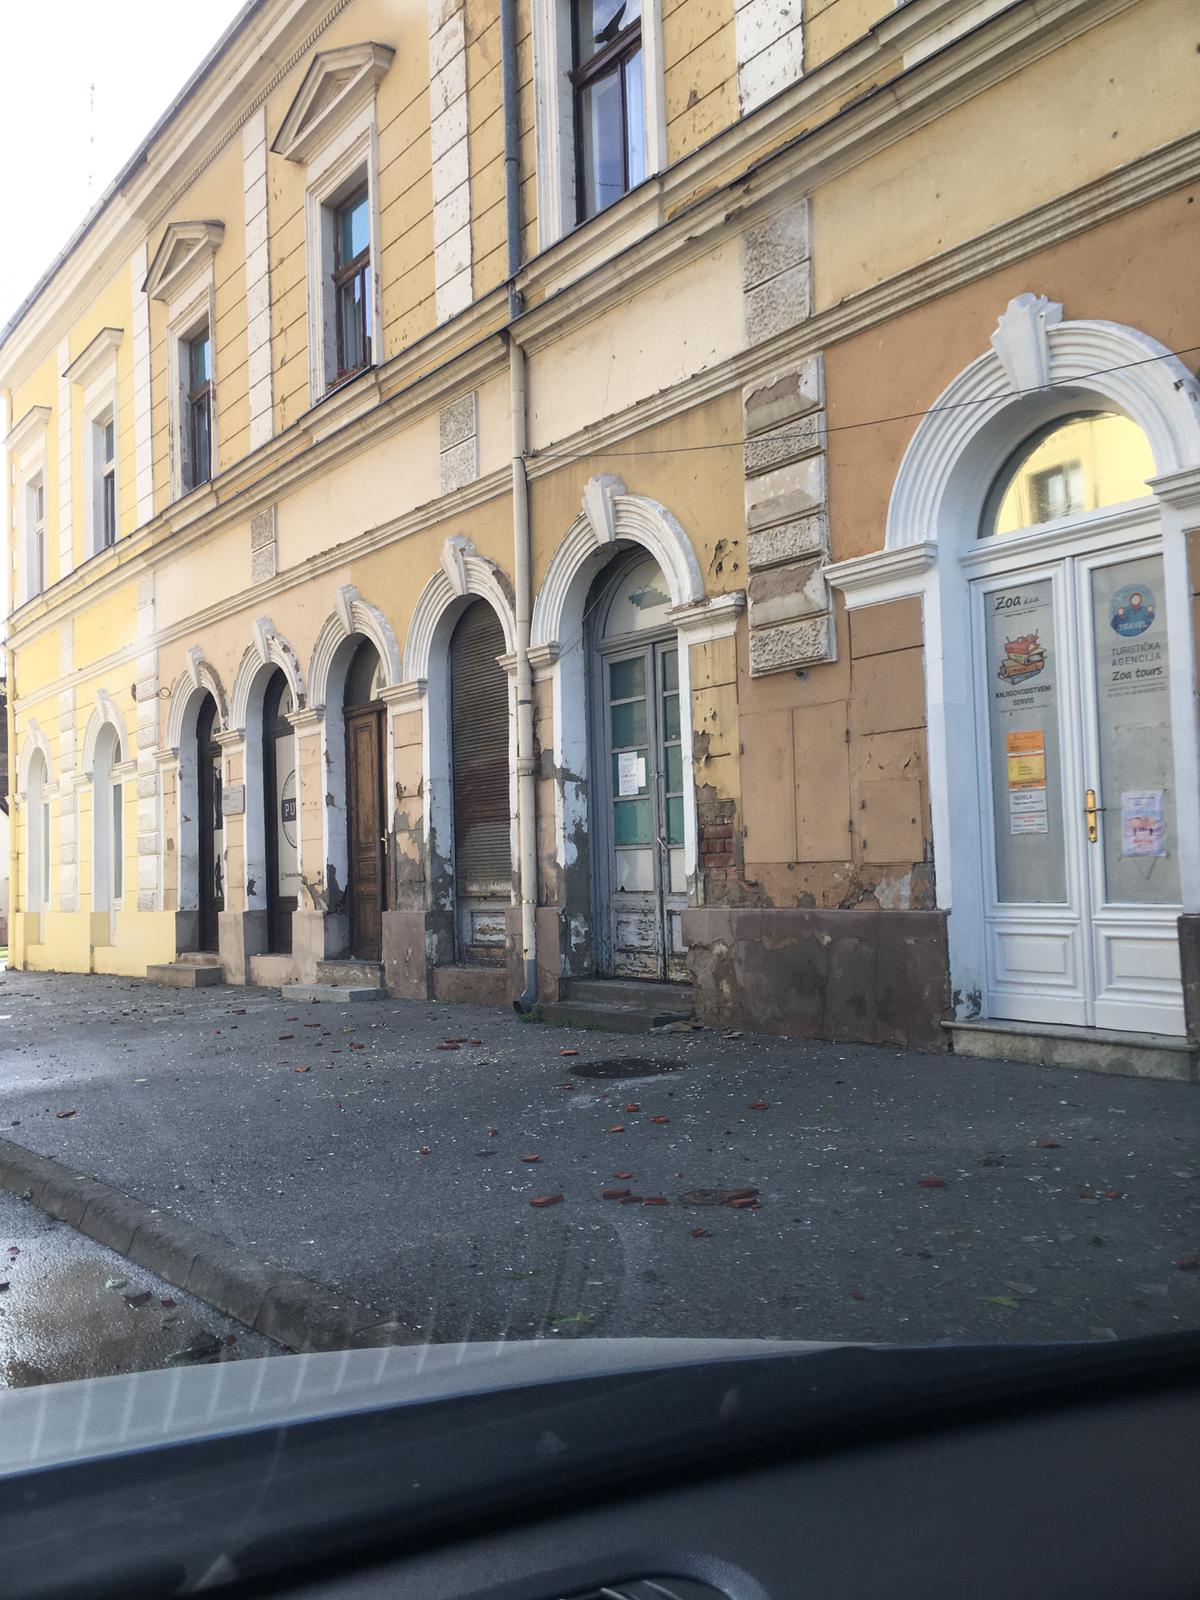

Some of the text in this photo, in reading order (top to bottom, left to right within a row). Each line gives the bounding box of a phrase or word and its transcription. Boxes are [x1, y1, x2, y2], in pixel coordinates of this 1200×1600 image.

[995, 596, 1022, 611] Zoa
[1117, 620, 1149, 632] TRAVEL
[1111, 641, 1161, 657] TURISTIČKA
[1111, 652, 1162, 668] AGENCIJA
[1111, 666, 1163, 682] Zoa tours
[1012, 697, 1035, 706] SERVIS
[284, 802, 295, 816] PU
